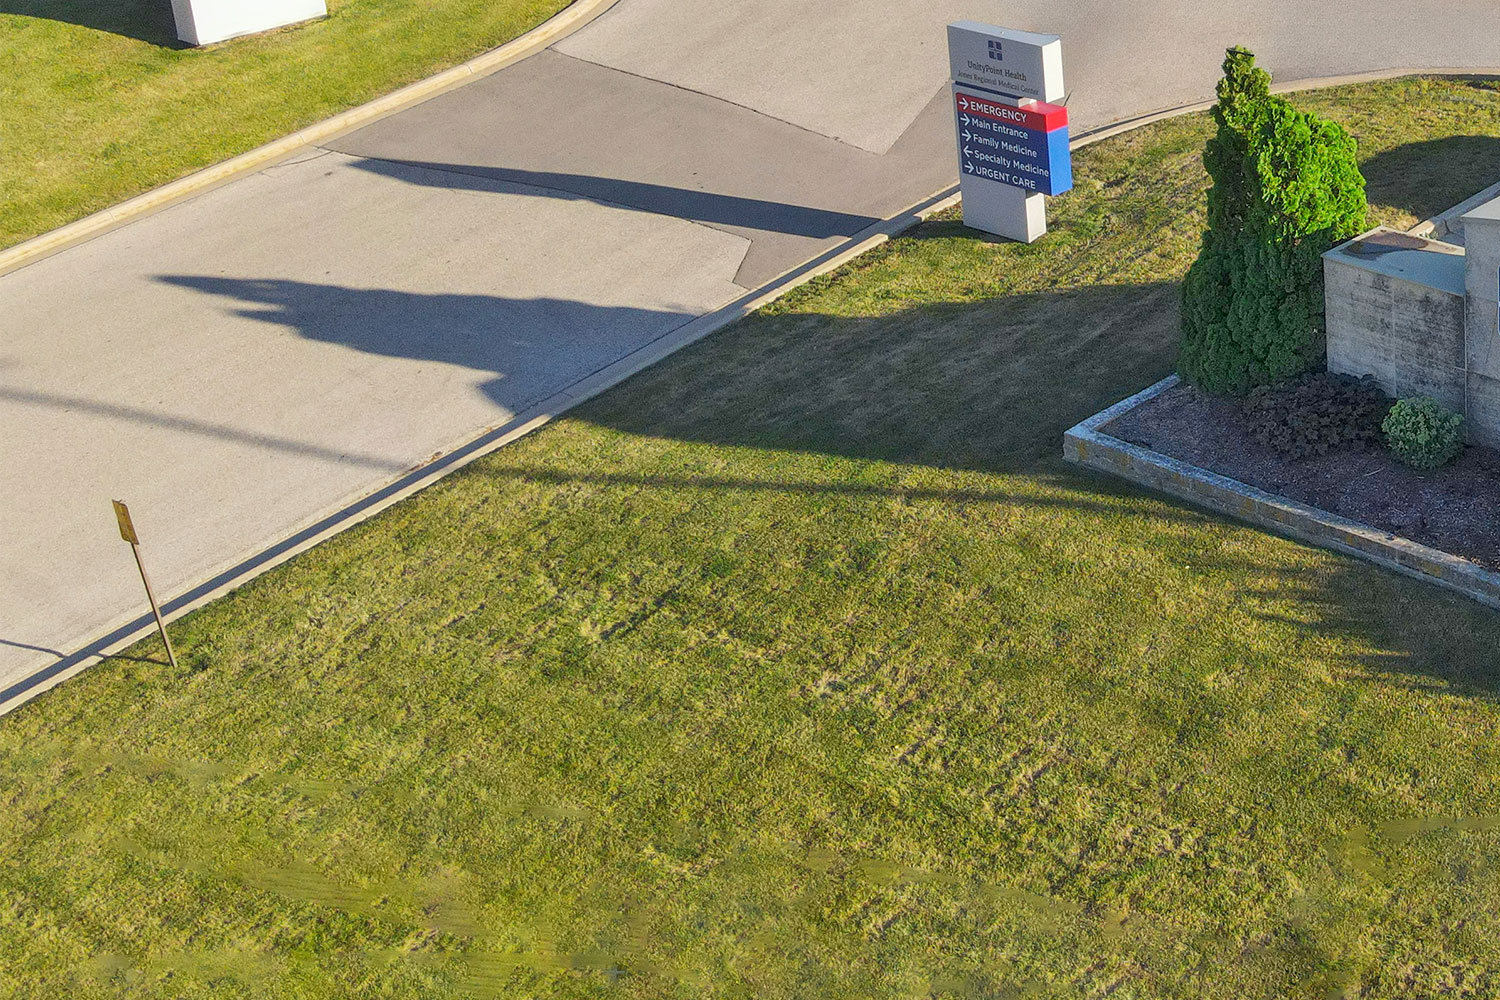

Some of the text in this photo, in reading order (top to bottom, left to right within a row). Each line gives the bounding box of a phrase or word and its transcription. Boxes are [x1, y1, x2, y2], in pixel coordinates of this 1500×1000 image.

[957, 70, 1039, 96] Jones Regional Medical Center
[968, 60, 1027, 82] UnityPoint Health
[970, 101, 1027, 123] EMERGENCY
[972, 118, 1028, 140] Main Entrance
[973, 134, 1038, 158] Family Medicine
[974, 150, 1049, 177] Specialty Medicine
[976, 165, 1036, 190] URGENT CARE
